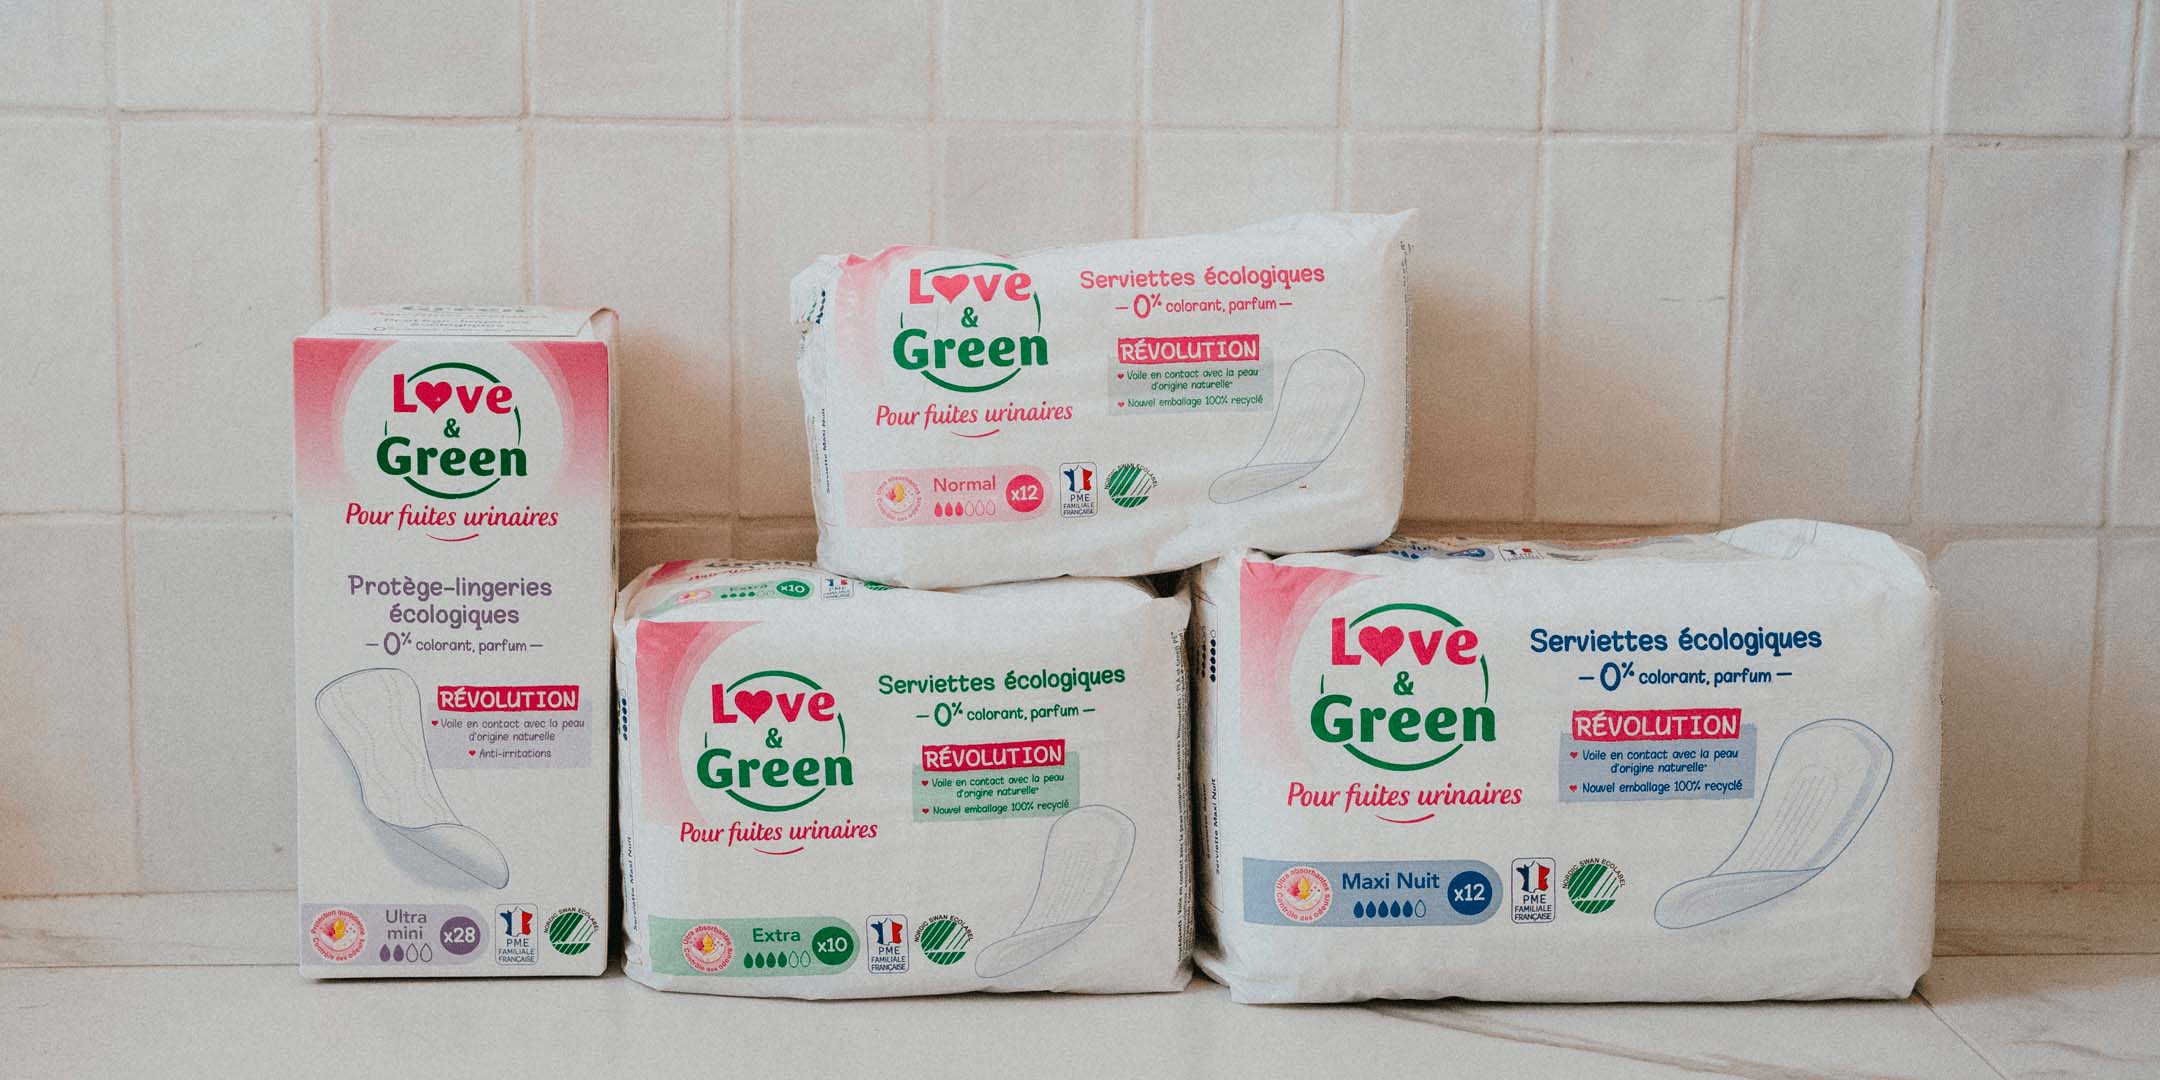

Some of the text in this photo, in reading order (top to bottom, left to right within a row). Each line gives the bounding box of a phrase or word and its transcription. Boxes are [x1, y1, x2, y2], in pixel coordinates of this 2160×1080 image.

[1079, 266, 1325, 290] Serviettes écologiques
[1133, 293, 1277, 319] 0% colorant, parfum
[961, 306, 979, 328] &
[893, 328, 1048, 370] Green
[1120, 339, 1257, 362] RÉVOLUTION
[1127, 370, 1147, 380] Voile
[1165, 370, 1199, 379] contact
[1203, 369, 1223, 378] avec
[1226, 368, 1234, 377] la
[1238, 368, 1258, 378] peau
[1151, 382, 1188, 392] d'origine
[1127, 394, 1263, 408] Nouvel emballage 100% recyclé
[875, 401, 1073, 431] Pour fuites urinaires
[443, 418, 460, 438] &
[376, 436, 528, 476] Green
[933, 475, 996, 493] Normal
[1011, 485, 1039, 501] x12
[1070, 494, 1090, 502] PME
[345, 503, 559, 531] Pour fuites urinaires
[348, 574, 553, 602] Protège-lingeries
[389, 603, 520, 630] écologiques
[383, 631, 527, 656] 0% colorant, parfum
[1530, 627, 1823, 657] Serviettes écologiques
[878, 667, 1126, 695] Serviettes écologiques
[1393, 671, 1414, 696] &
[1599, 661, 1772, 692] 0% colorant, parfum
[439, 687, 576, 709] RÉVOLUTION
[934, 701, 1079, 727] 0% colorant, parfum
[1310, 694, 1496, 743] Green
[440, 718, 585, 731] Voile en contact avec la peau
[1575, 712, 1737, 738] RÉVOLUTION
[468, 731, 556, 743] d'origine naturelle
[765, 727, 783, 749] &
[479, 748, 551, 759] Anti-irritations
[924, 745, 1063, 768] RÉVOLUTION
[1583, 748, 1738, 762] Voile en contact avec la peau
[696, 748, 854, 789] Green
[1611, 763, 1654, 776] d'origine
[932, 778, 951, 787] Voile
[970, 777, 1004, 786] contact
[1008, 776, 1028, 784] avec
[1032, 774, 1039, 783] la
[1043, 775, 1064, 784] peau
[1583, 779, 1743, 795] Nouvel emballage 100% recyclé
[957, 788, 993, 799] d'origine
[1287, 781, 1523, 813] Pour fuites urinaires
[933, 799, 1069, 815] Nouvel emballage 100% recyclé
[680, 818, 878, 847] Pour fuites urinaires
[1341, 872, 1440, 890] Maxi Nuit
[1562, 857, 1626, 889] NORDIC SWAN ECOLABEL
[1454, 884, 1485, 902] x12
[1523, 894, 1546, 904] PME
[385, 908, 427, 924] Ultra
[1515, 913, 1552, 921] FRANÇAISE
[387, 926, 423, 940] mini
[443, 926, 476, 944] x28
[752, 928, 800, 943] Extra
[929, 914, 948, 922] SWAN
[949, 915, 974, 941] ECOLABEL
[498, 948, 535, 956] FAMILIALE
[506, 938, 529, 948] PME
[817, 937, 847, 953] x10
[879, 946, 900, 955] PME
[498, 955, 535, 963] FRANÇAISE
[871, 963, 906, 972] FRANÇAISE
